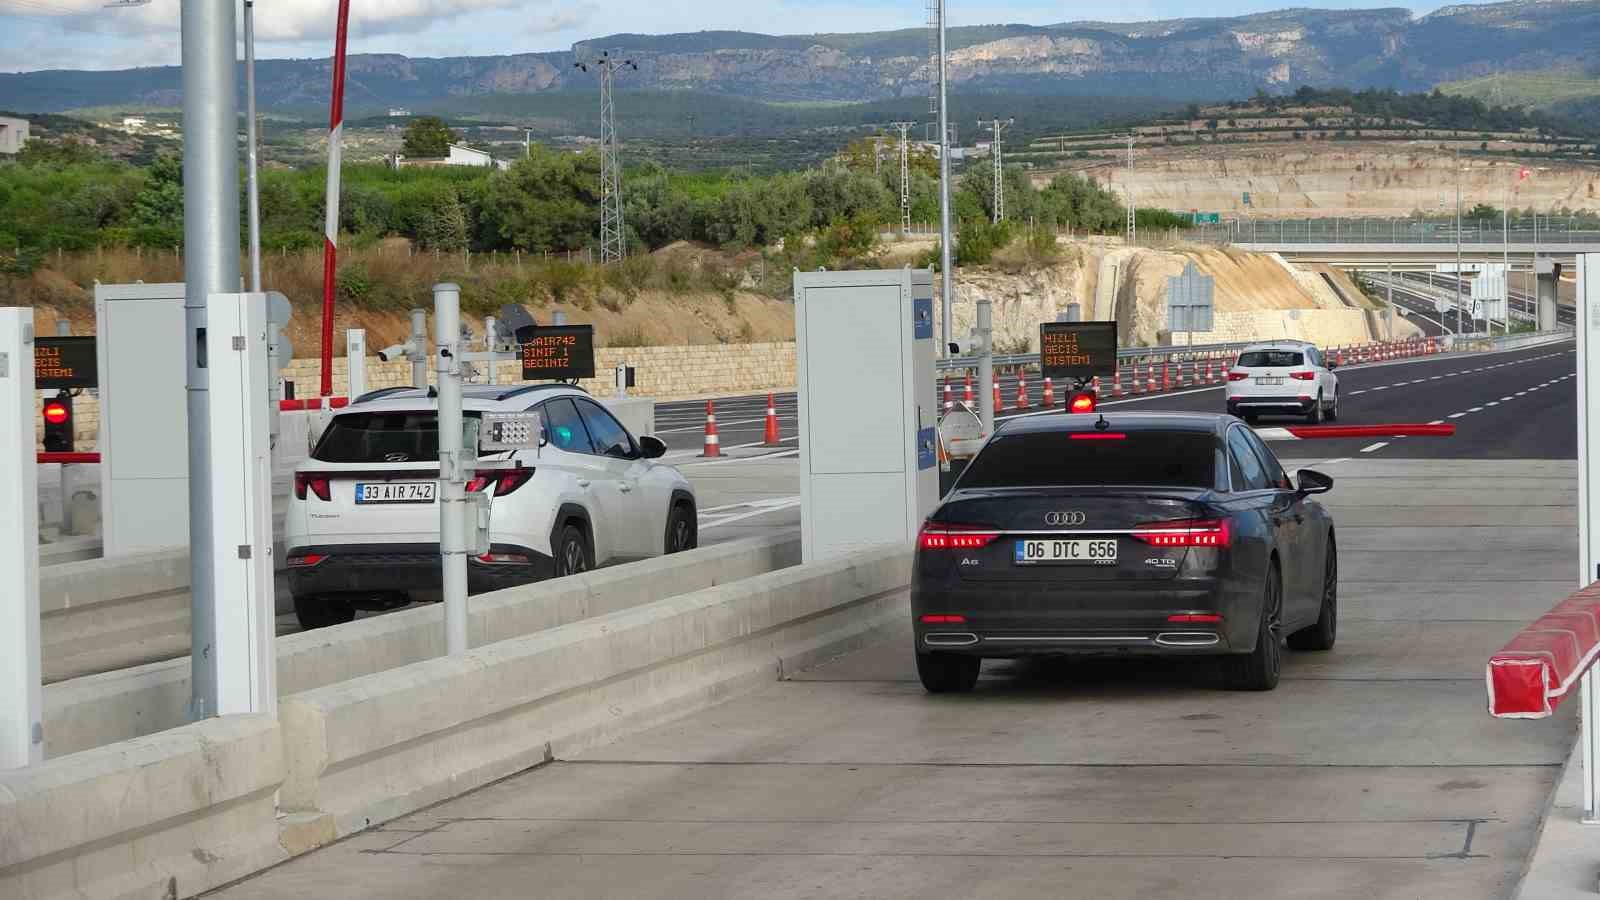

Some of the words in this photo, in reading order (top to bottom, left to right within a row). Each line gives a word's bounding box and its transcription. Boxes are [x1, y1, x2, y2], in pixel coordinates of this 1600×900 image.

[1044, 333, 1077, 343] HIZLI
[35, 347, 60, 357] IZLI
[524, 347, 556, 358] SINIF
[563, 347, 569, 357] 1
[35, 358, 62, 368] ECIS
[35, 368, 73, 378] ISTEMI
[365, 486, 379, 499] 33
[384, 486, 405, 498] AIR
[409, 485, 431, 498] 742
[1027, 542, 1045, 557] 06
[1053, 542, 1080, 557] DTC
[1089, 542, 1116, 557] 656
